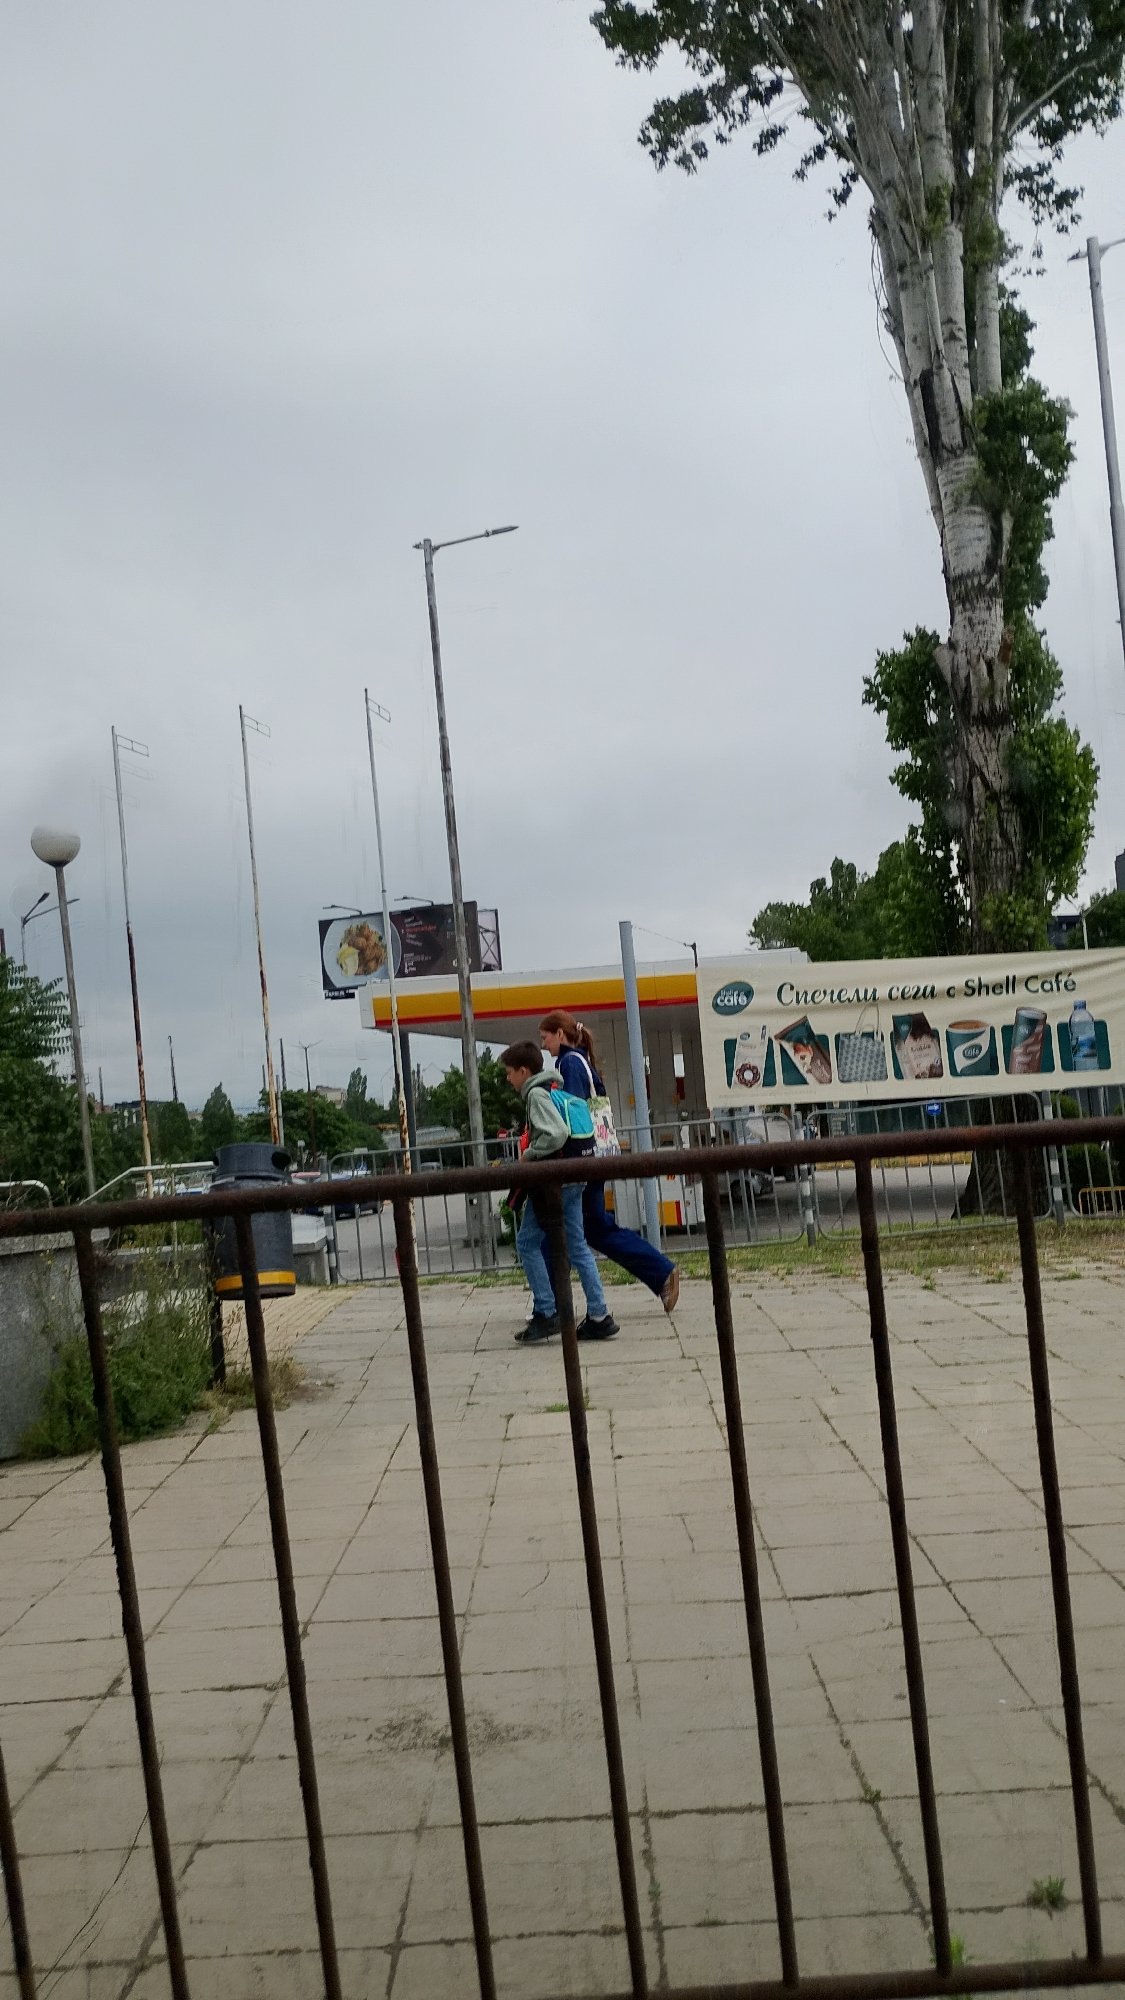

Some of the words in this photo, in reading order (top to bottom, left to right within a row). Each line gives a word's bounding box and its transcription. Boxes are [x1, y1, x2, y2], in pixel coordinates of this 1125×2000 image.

[776, 982, 880, 1007] Спечели
[887, 984, 938, 1000] сега
[963, 974, 1017, 998] Shell
[1024, 972, 1077, 994] Café
